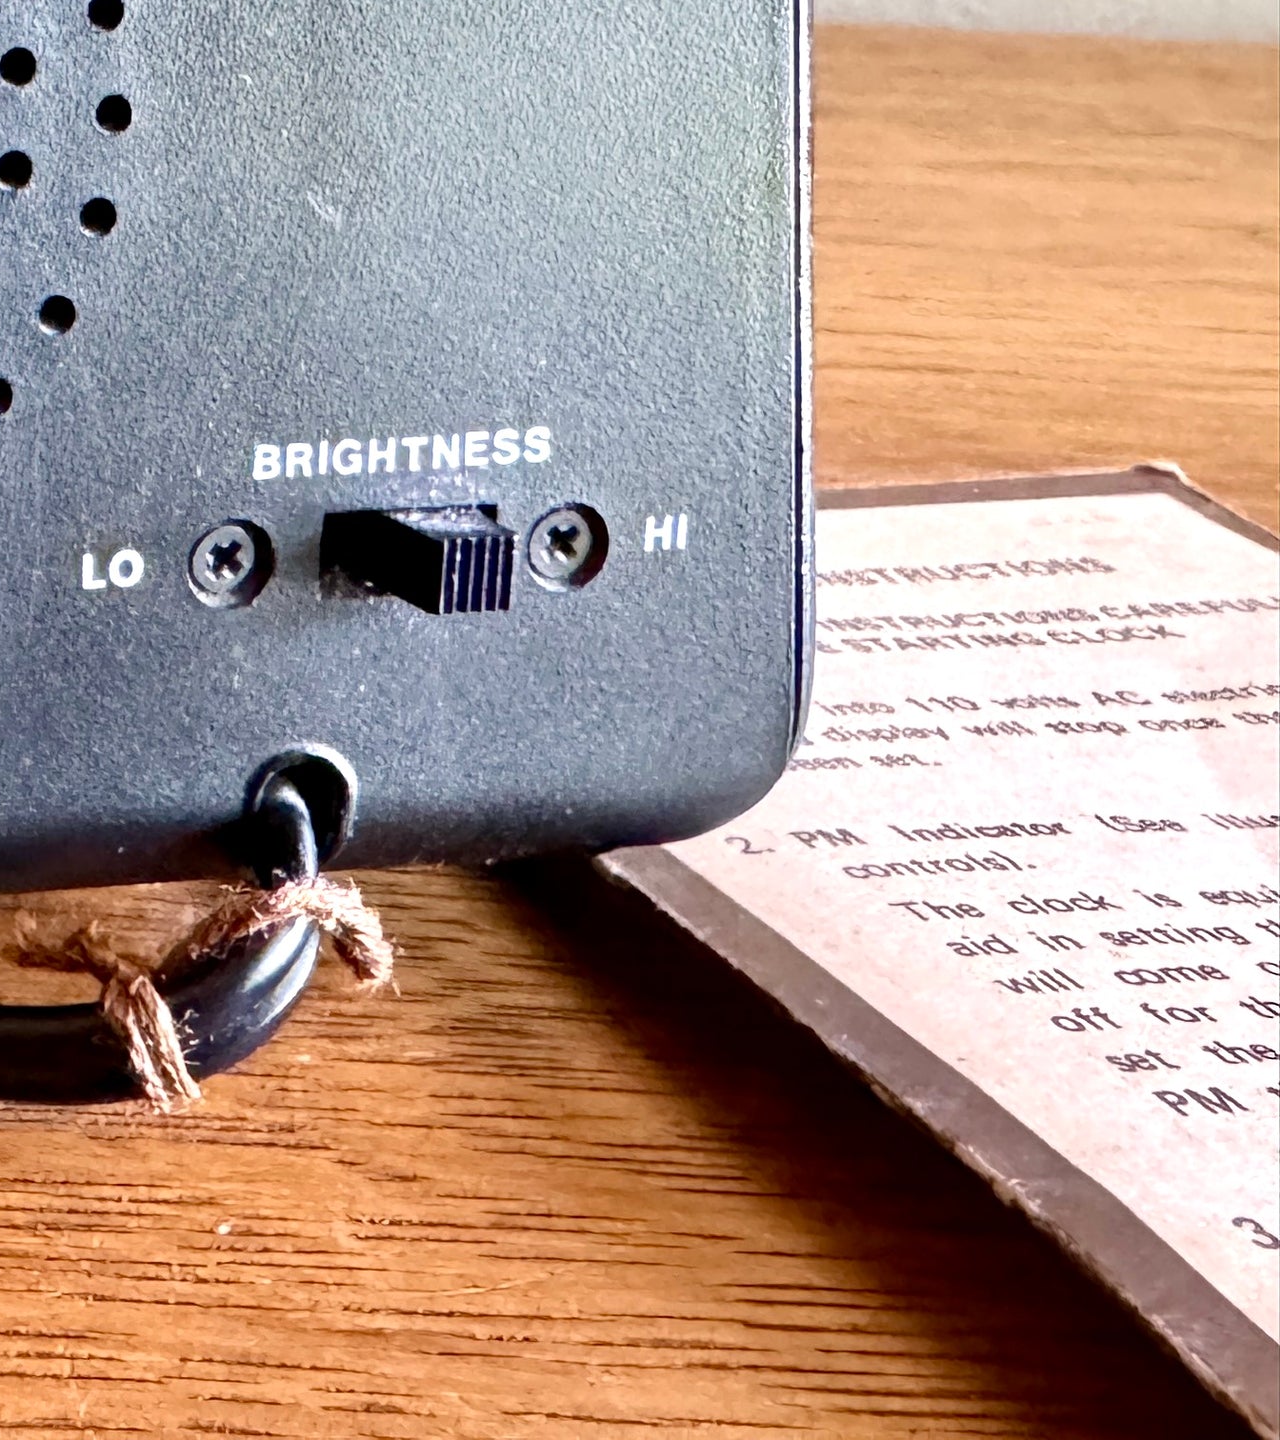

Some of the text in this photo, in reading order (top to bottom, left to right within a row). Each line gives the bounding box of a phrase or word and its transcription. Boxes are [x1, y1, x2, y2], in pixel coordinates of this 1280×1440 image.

[250, 423, 553, 481] BRIGHTNESS
[642, 510, 689, 555] HI
[81, 548, 145, 590] LO
[1046, 623, 1187, 646] CLOCK
[903, 694, 982, 713] 110
[1090, 688, 1154, 706] AC
[788, 828, 868, 849] PM
[888, 822, 1072, 842] Indicator
[888, 900, 986, 922] The
[1007, 890, 1123, 915] clock
[1132, 888, 1183, 909] is
[945, 933, 1019, 958] aid
[1027, 931, 1086, 953] in
[1098, 926, 1252, 948] setting
[993, 967, 1085, 995] will
[1113, 964, 1231, 987] come
[1050, 1006, 1123, 1033] off
[1139, 1002, 1218, 1025] for
[1105, 1049, 1182, 1073] set
[1152, 1086, 1250, 1117] PM
